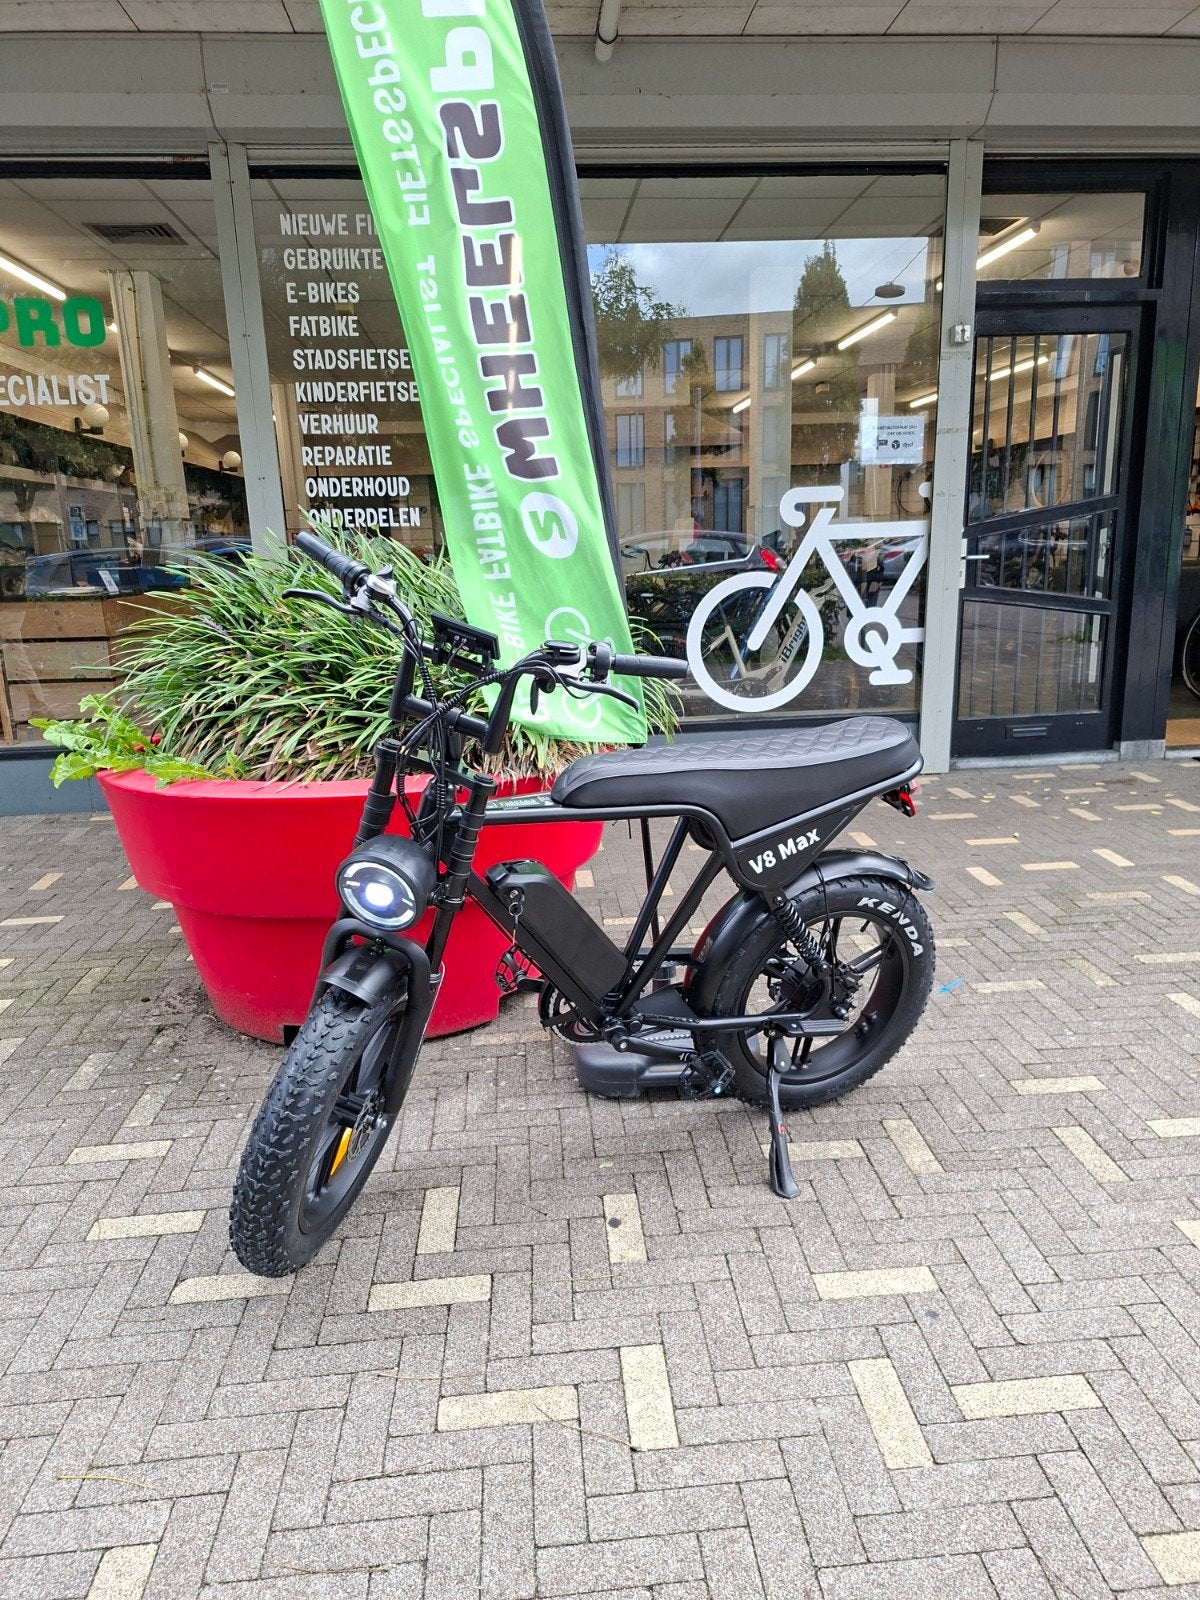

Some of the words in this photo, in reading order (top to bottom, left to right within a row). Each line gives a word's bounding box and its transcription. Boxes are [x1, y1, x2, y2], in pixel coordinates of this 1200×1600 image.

[280, 213, 349, 235] NIEUWE
[283, 248, 384, 270] GEBRUIKTE
[286, 282, 360, 304] E-BIKES
[0, 296, 107, 348] RO
[289, 315, 360, 337] FATBIKE
[293, 348, 411, 370] STADSFIETSE
[295, 381, 420, 403] KINDERFIETSE
[298, 413, 379, 435] VERHUUR
[301, 445, 393, 467] REPARATIE
[305, 476, 411, 498] ONDERHOUD
[309, 507, 421, 528] ONDERDELEN
[748, 851, 777, 875] V8
[777, 827, 821, 860] Max
[857, 896, 924, 957] KENDA
